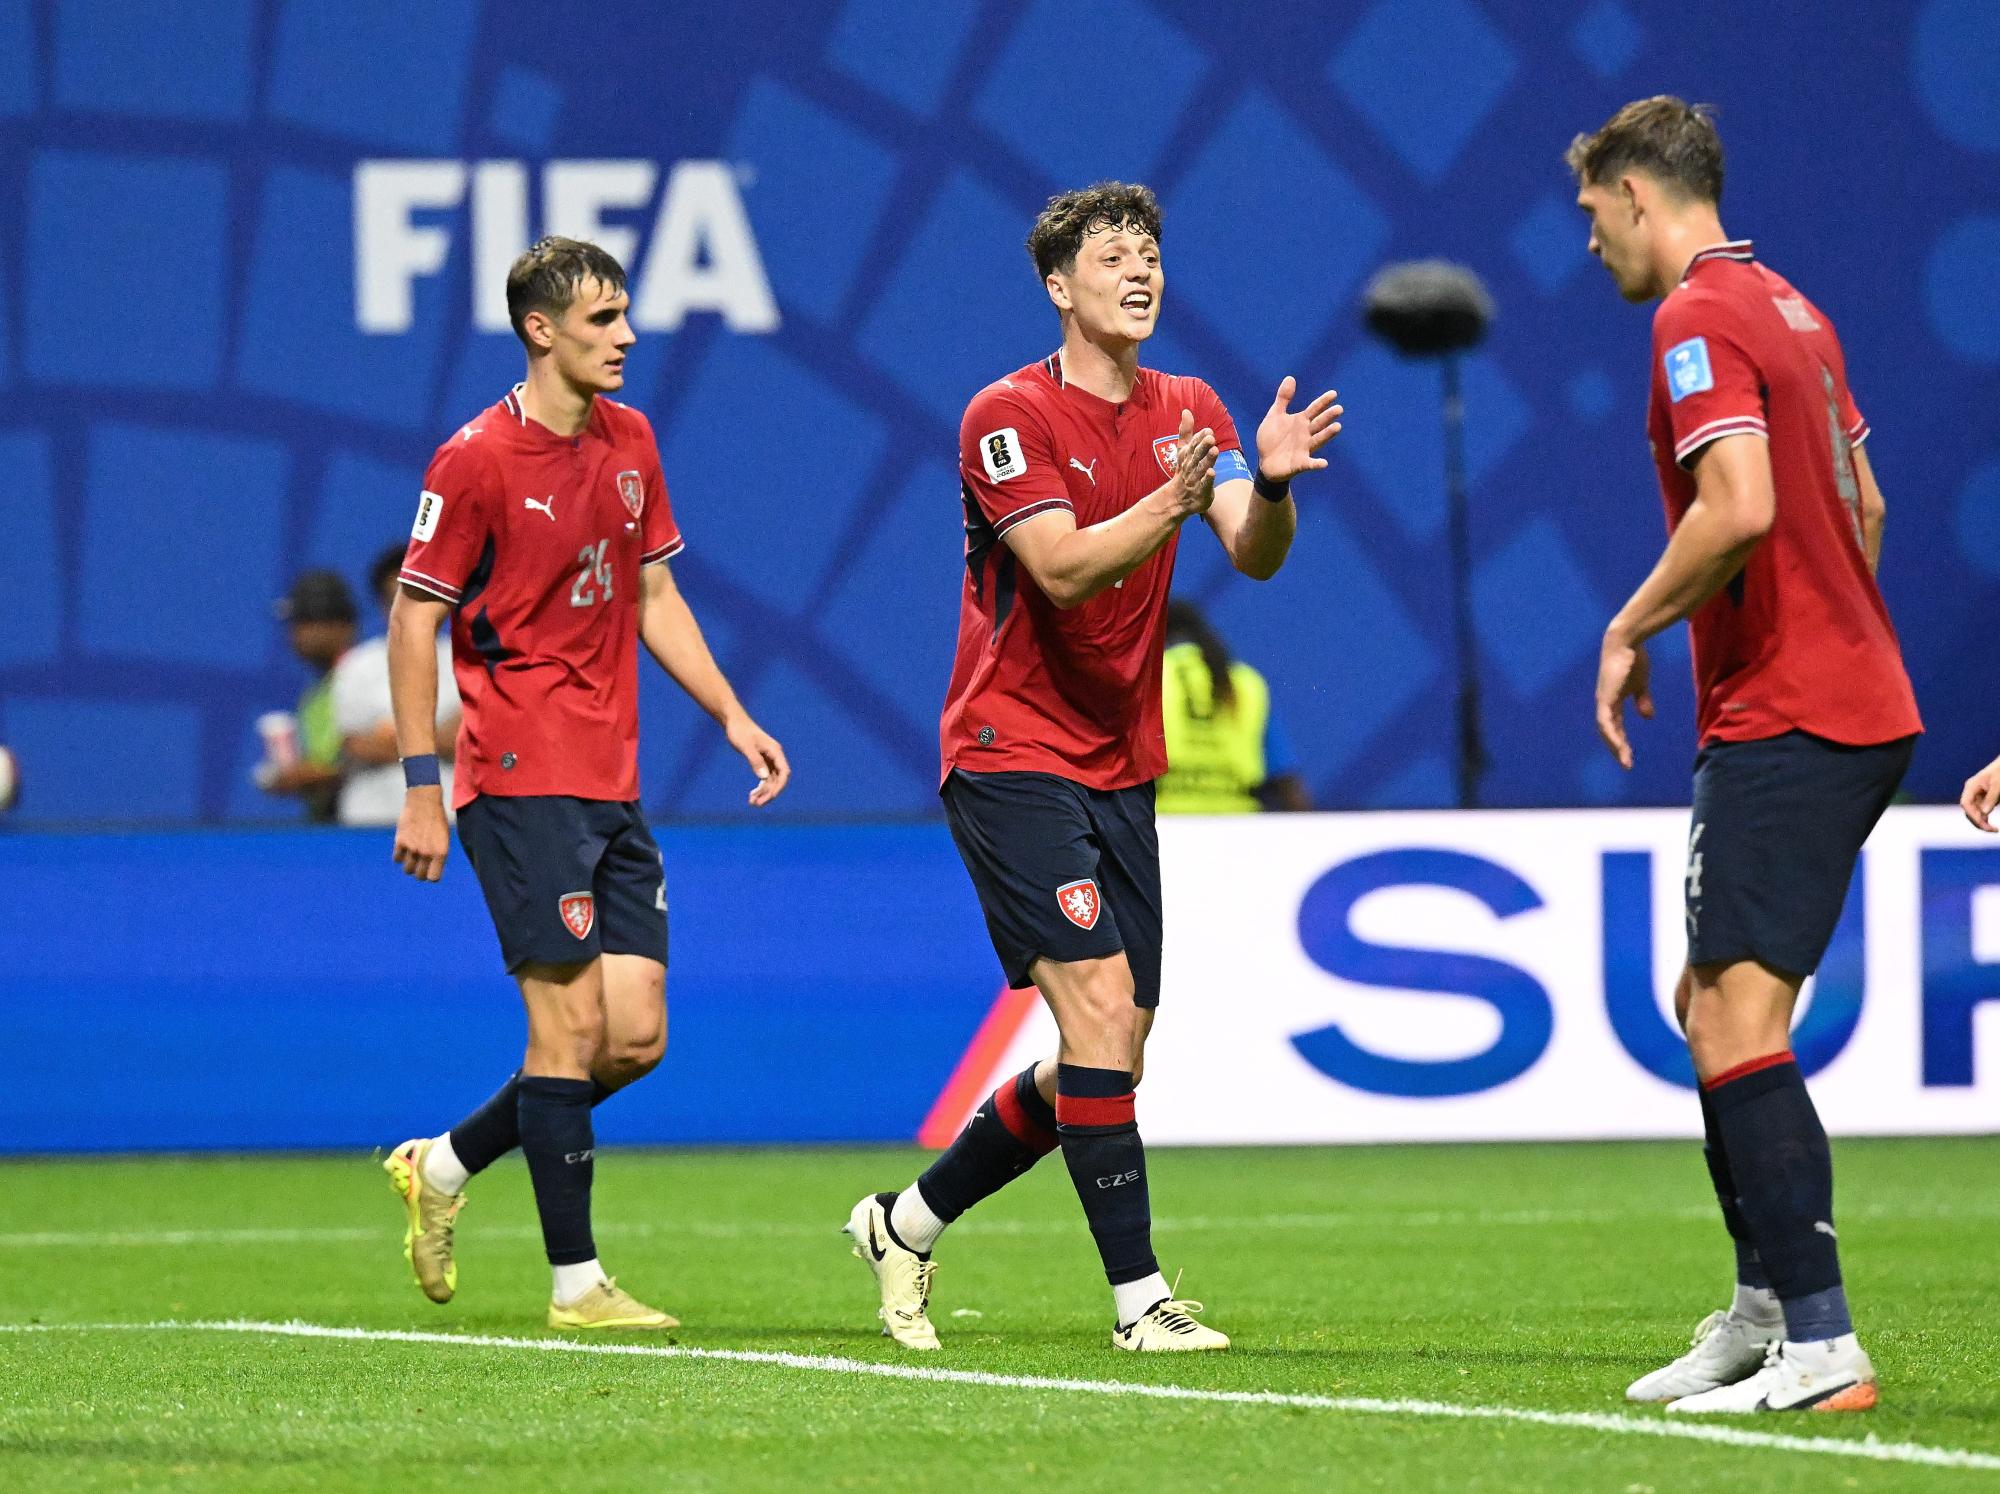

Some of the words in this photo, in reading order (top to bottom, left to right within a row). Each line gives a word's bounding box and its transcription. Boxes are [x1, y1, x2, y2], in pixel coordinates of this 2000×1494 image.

[354, 160, 780, 333] FIFA
[570, 538, 613, 608] 24
[1096, 1169, 1140, 1189] CZE
